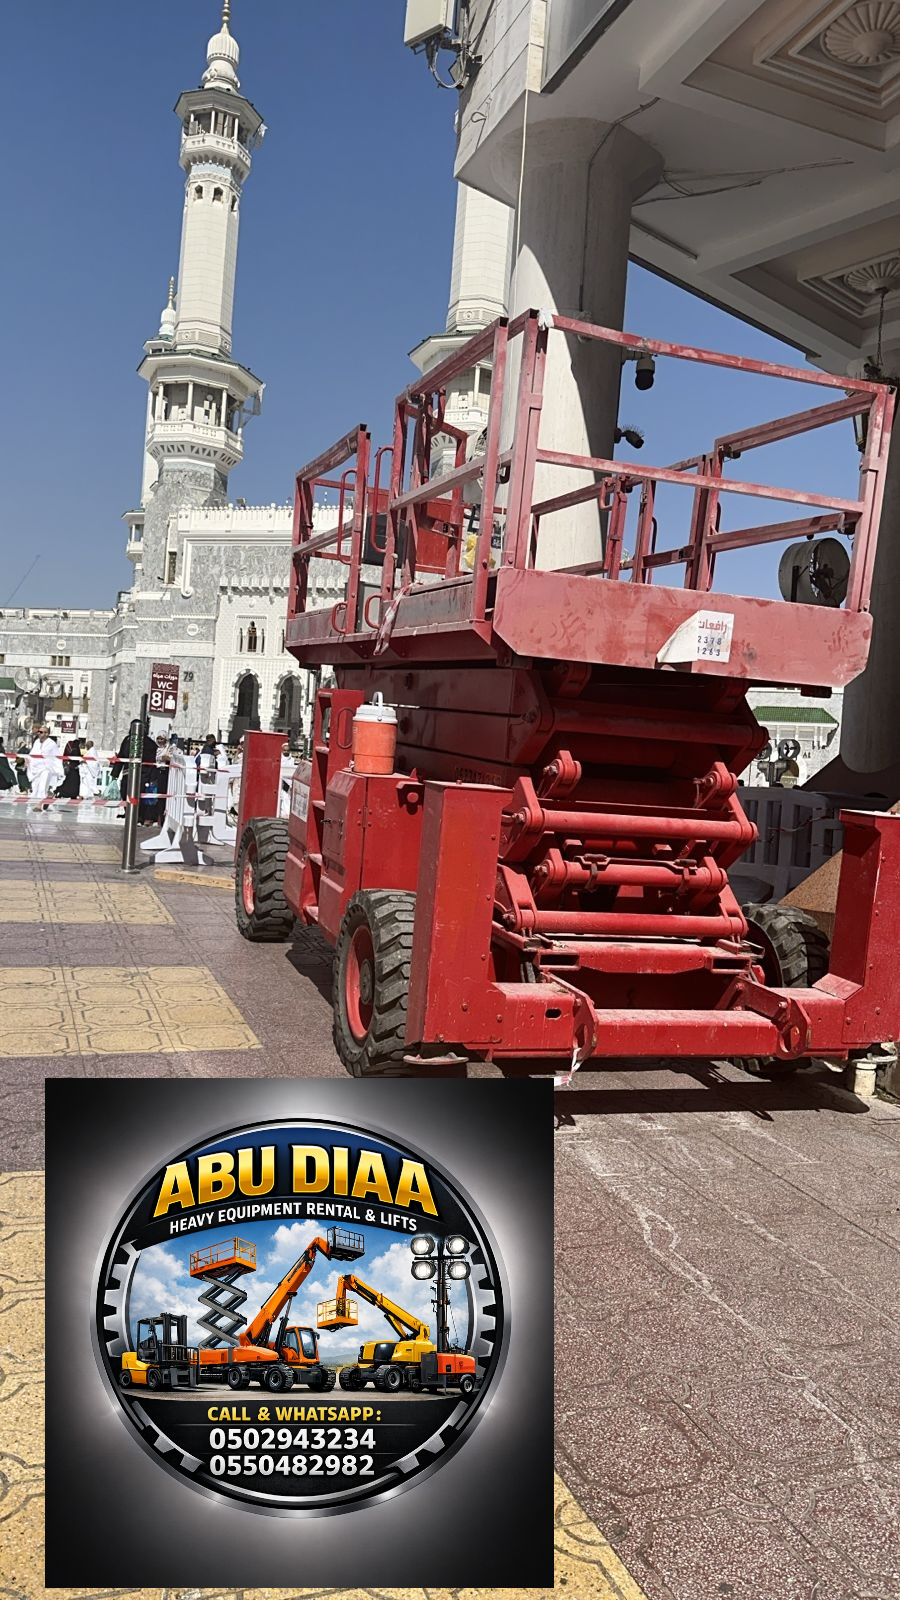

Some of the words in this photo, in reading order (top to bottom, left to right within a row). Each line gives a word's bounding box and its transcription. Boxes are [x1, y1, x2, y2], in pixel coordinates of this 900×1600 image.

[183, 671, 194, 682] 79
[157, 680, 174, 690] WC
[151, 691, 162, 707] 8
